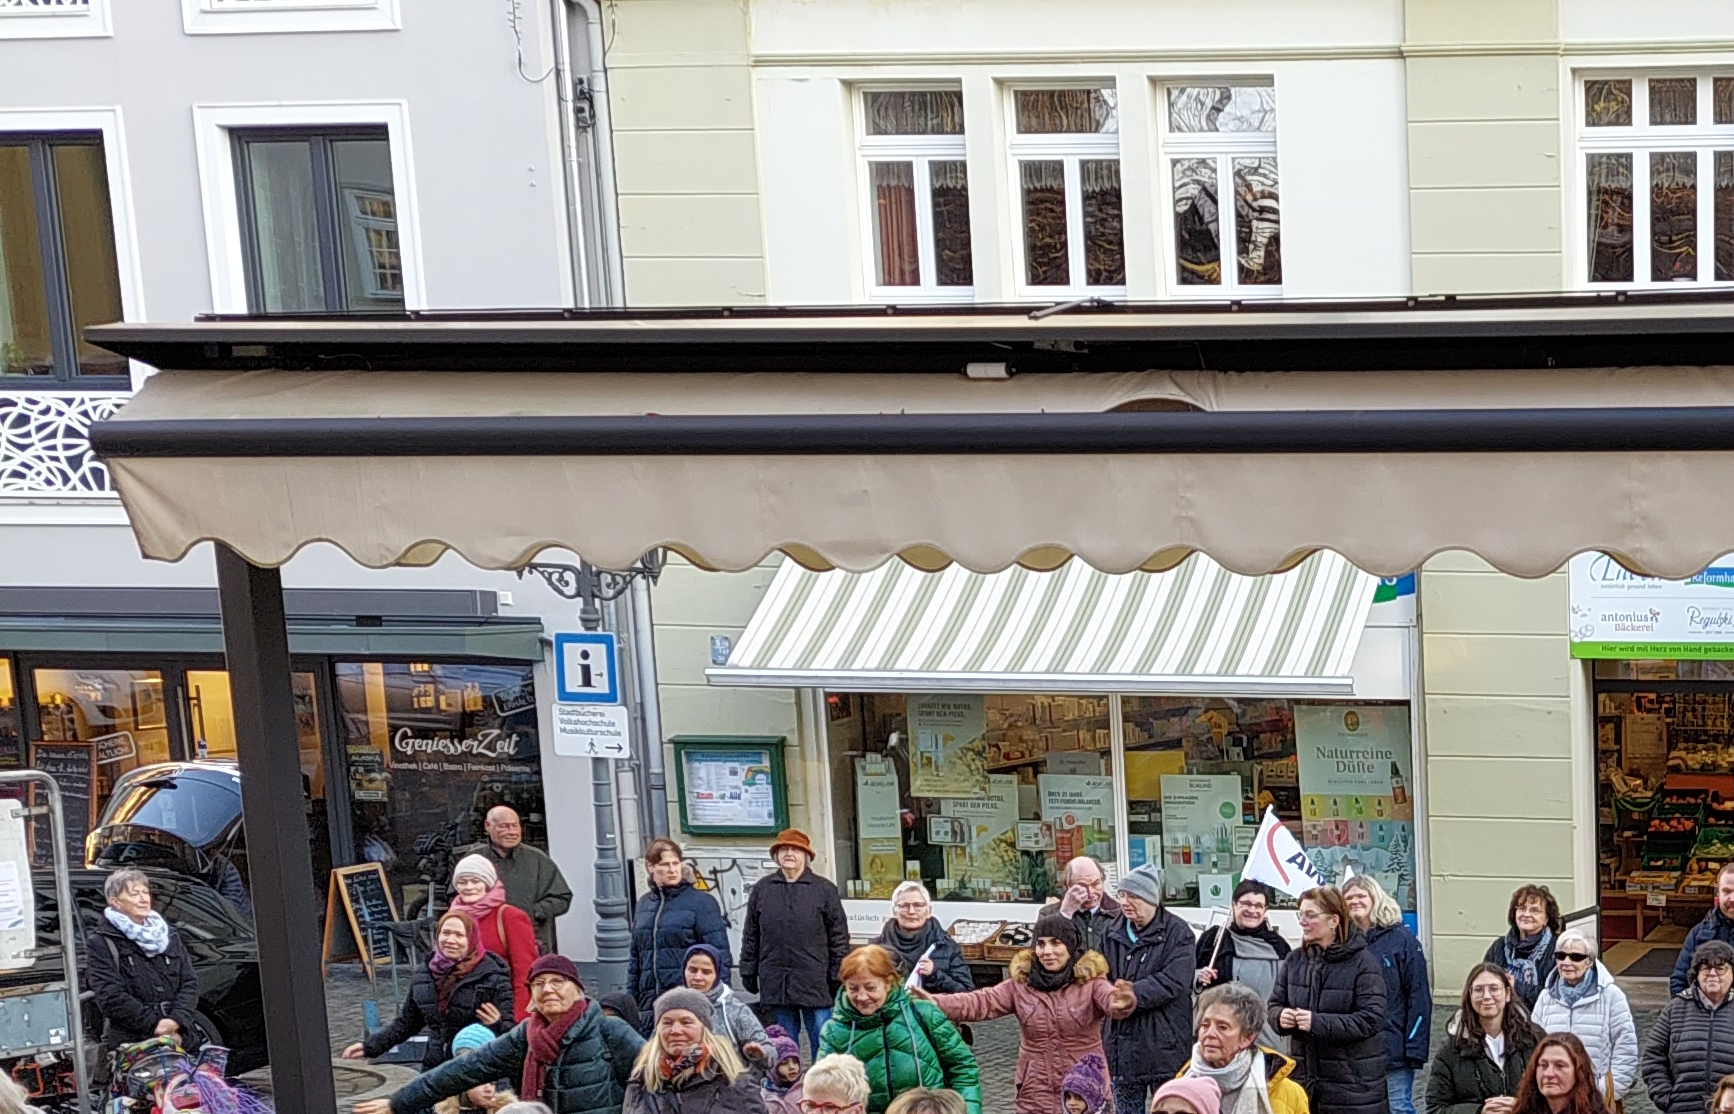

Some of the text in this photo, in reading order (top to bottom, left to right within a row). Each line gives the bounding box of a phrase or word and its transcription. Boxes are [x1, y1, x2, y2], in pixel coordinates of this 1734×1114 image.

[1601, 611, 1649, 622] antonius
[1614, 623, 1655, 632] Bäckerei
[1683, 645, 1702, 653] Hand
[558, 707, 605, 717] Stadtbücherei
[559, 717, 616, 727] Volkshochschule
[1315, 746, 1393, 760] Naturreine
[389, 761, 419, 770] Vinothek
[422, 761, 440, 770] Café
[442, 762, 464, 771] Bistro
[1335, 760, 1375, 773] Düfte
